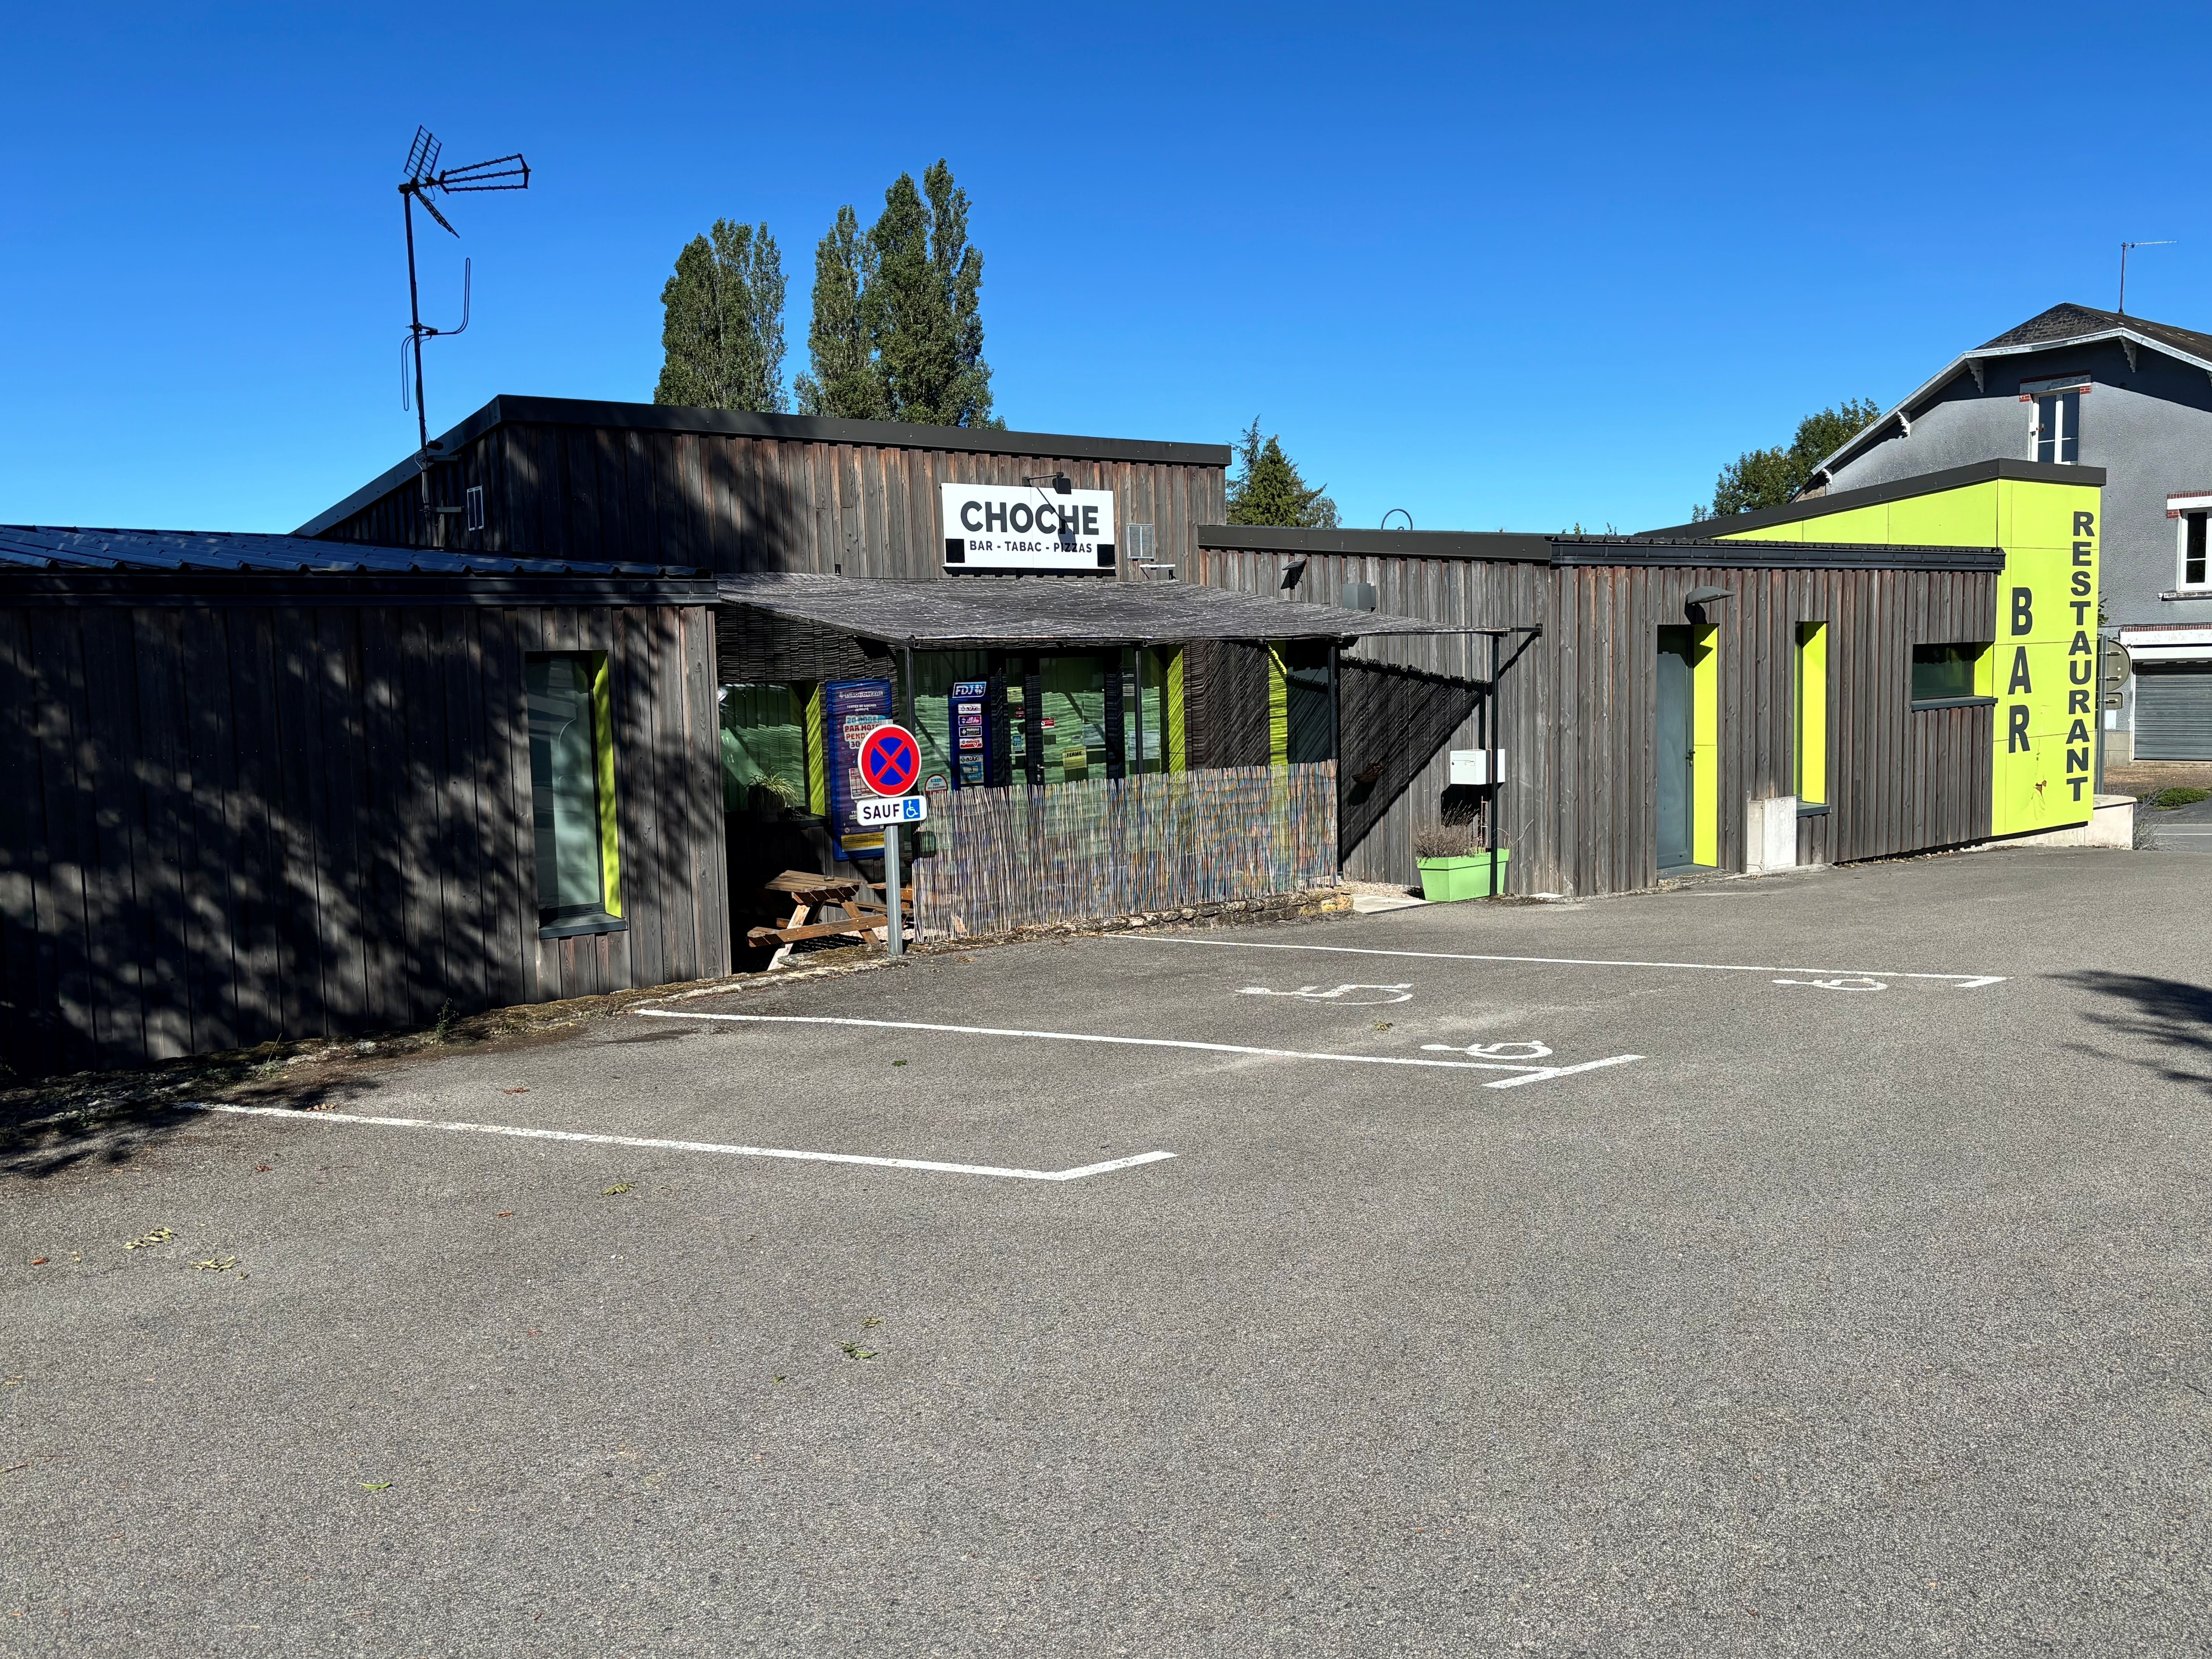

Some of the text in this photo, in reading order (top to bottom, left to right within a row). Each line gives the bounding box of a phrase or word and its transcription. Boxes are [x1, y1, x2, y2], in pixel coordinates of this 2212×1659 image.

[960, 501, 1099, 535] CHOCHE
[970, 540, 993, 551] BAR
[1005, 541, 1041, 552] TABAC
[1054, 542, 1092, 553] PIZZAS
[2066, 511, 2095, 802] RESTAURANT
[2008, 587, 2033, 754] BAR
[955, 685, 974, 696] FDJ
[863, 803, 900, 820] SAUF
